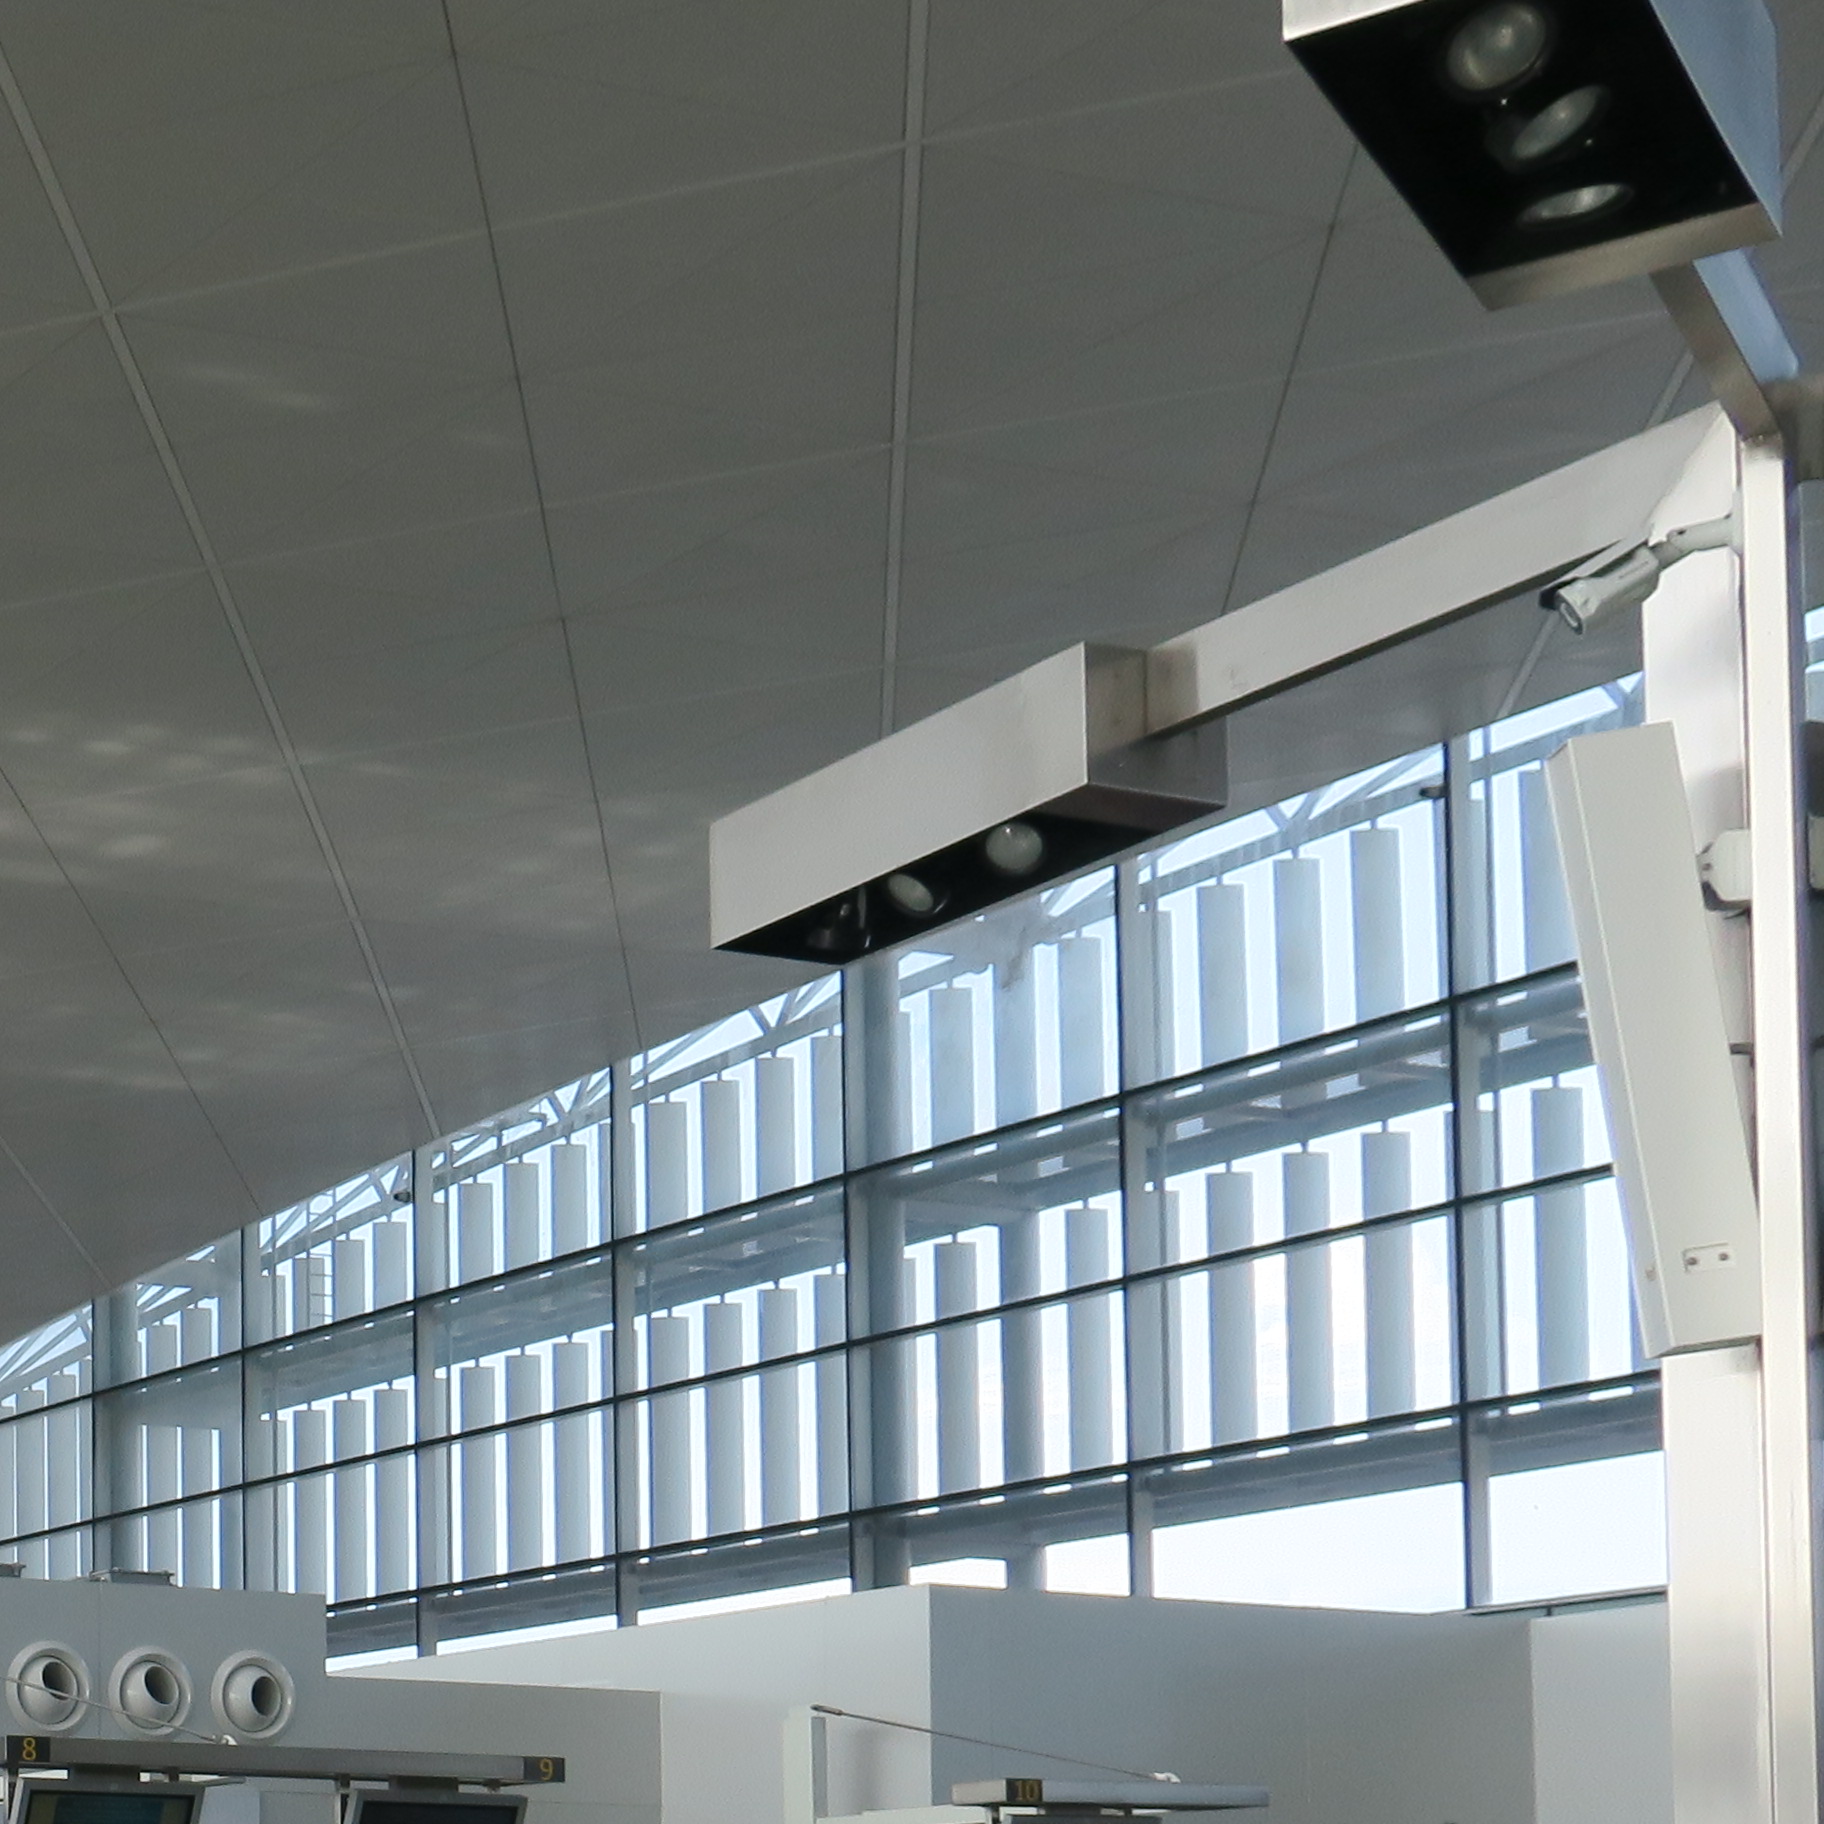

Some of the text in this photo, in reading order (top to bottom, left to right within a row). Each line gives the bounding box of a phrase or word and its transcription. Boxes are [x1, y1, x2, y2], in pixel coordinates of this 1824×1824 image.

[22, 1737, 36, 1761] 8
[539, 1758, 554, 1781] 9
[1013, 1780, 1040, 1801] 10
